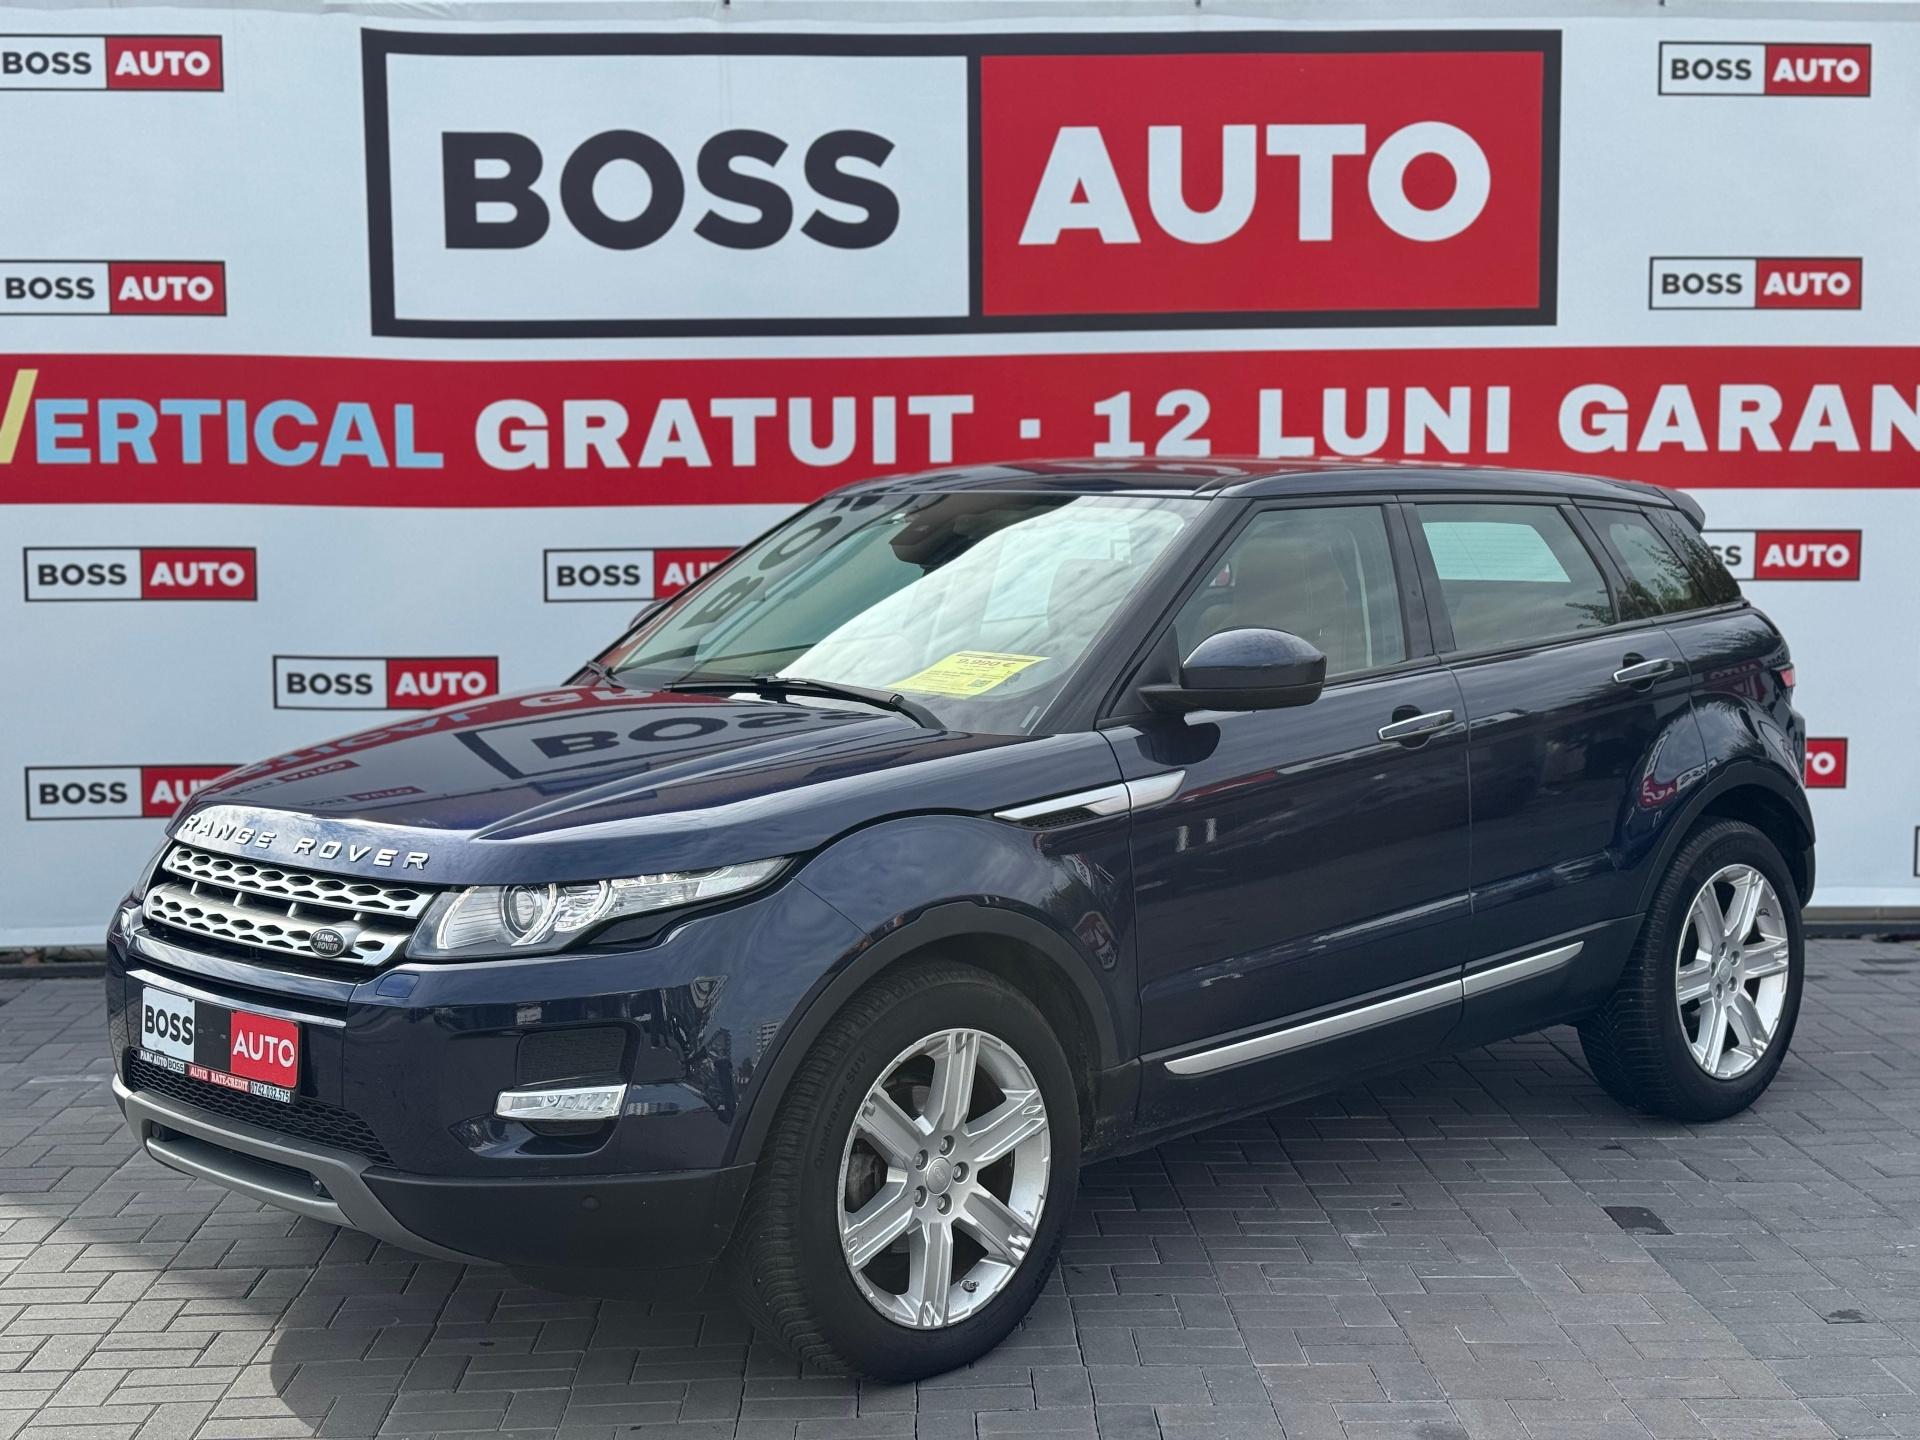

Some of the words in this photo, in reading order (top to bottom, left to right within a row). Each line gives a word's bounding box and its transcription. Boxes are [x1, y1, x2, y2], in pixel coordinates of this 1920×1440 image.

[3, 52, 91, 74] BOSS
[115, 51, 210, 76] AUTO
[1672, 59, 1751, 80] BOSS
[1773, 58, 1860, 82] AUTO
[442, 130, 899, 250] BOSS
[1019, 121, 1490, 245] AUTO
[6, 278, 94, 299] BOSS
[119, 277, 213, 301] AUTO
[1663, 274, 1742, 294] BOSS
[1764, 272, 1851, 296] AUTO
[476, 395, 973, 469] GRATUIT
[1094, 389, 1210, 456] 12
[1258, 386, 1510, 457] LUNI
[1763, 544, 1849, 567] AUTO
[38, 564, 126, 586] BOSS
[151, 563, 244, 586] AUTO
[557, 565, 640, 586] BOSS
[662, 562, 716, 586] AU
[286, 673, 373, 695] BOSS
[396, 672, 487, 696] AUTO
[40, 782, 127, 804] BOSS
[151, 780, 211, 804] AU
[183, 814, 276, 848] RANGE
[293, 838, 429, 870] ROVER
[316, 933, 334, 943] LAND
[317, 941, 338, 951] ROVER
[144, 1005, 194, 1045] BOSS
[232, 1029, 295, 1067] AUTO
[168, 1060, 184, 1073] BOSS
[190, 1067, 207, 1079] AUTO
